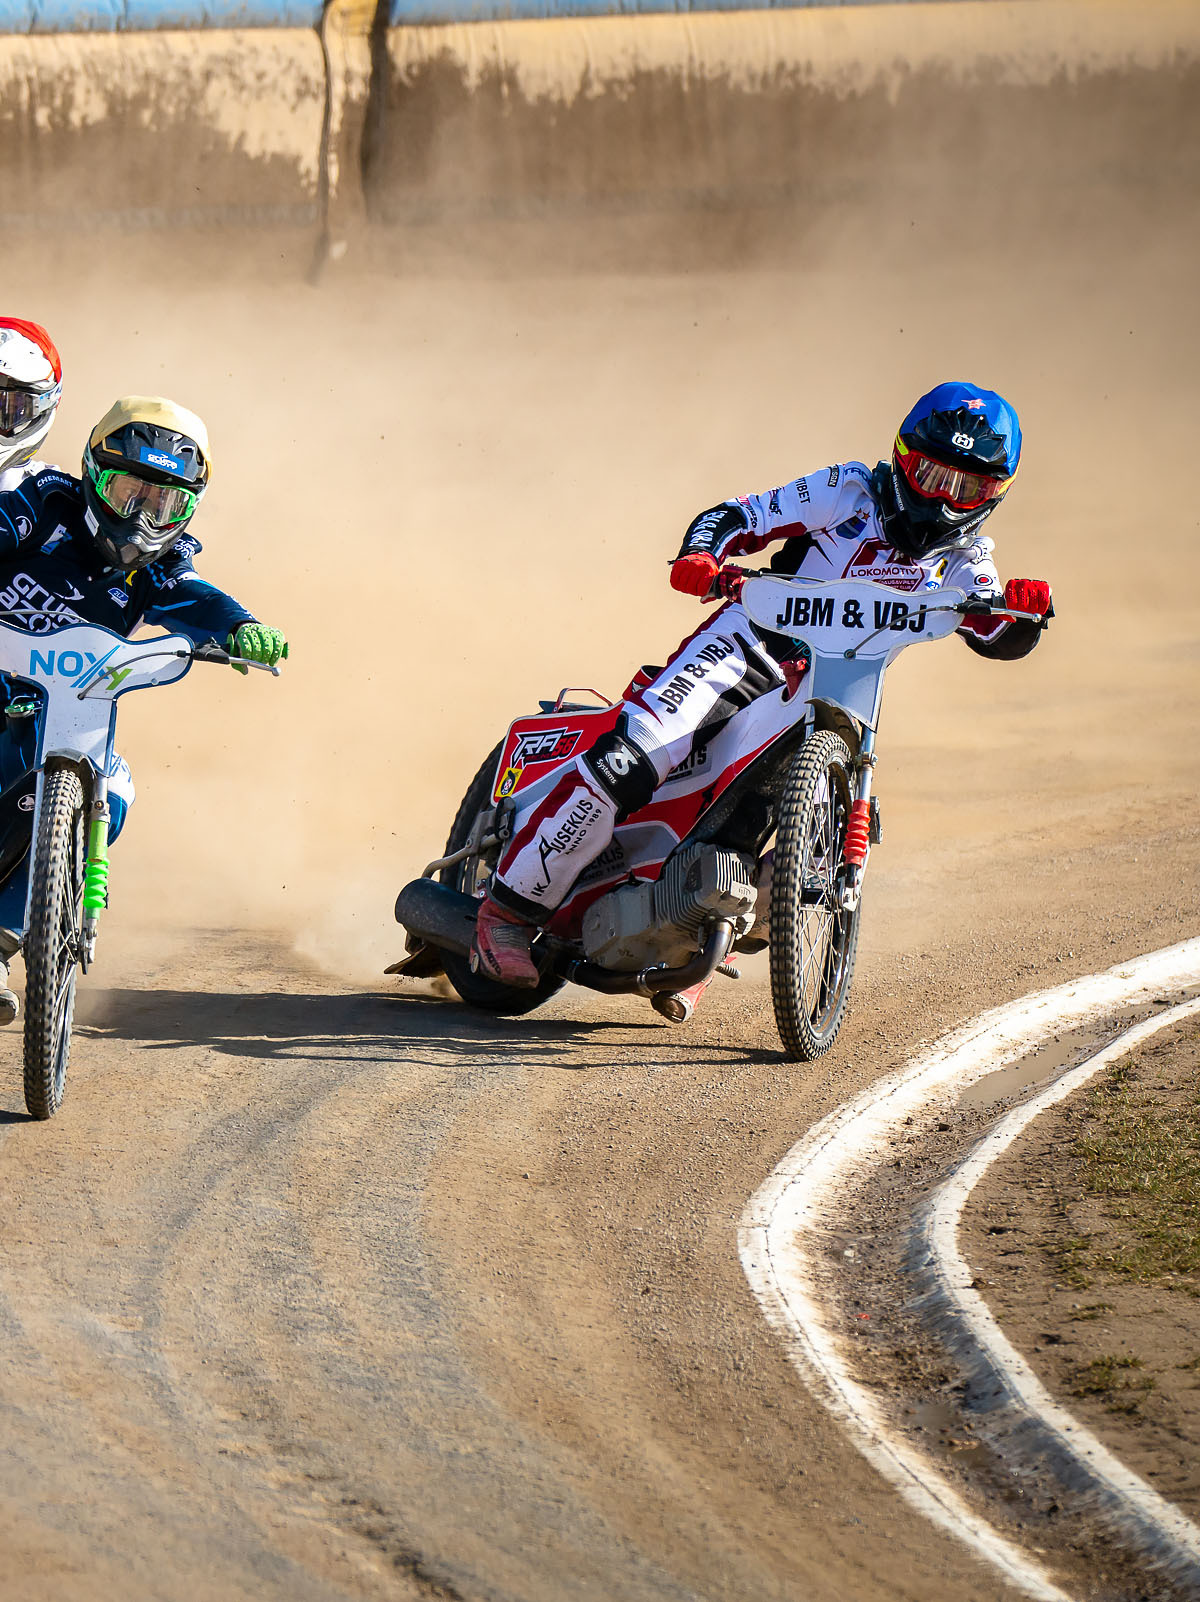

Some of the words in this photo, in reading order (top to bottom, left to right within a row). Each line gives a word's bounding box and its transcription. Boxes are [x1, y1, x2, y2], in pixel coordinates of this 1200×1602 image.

[36, 474, 73, 489] CHEMART
[851, 567, 918, 577] LOKOMOTIV
[776, 597, 835, 627] JBM
[841, 599, 864, 628] &
[874, 600, 928, 633] VBJ
[695, 636, 735, 667] VBJ
[683, 663, 710, 679] &
[657, 675, 696, 714] JBM
[597, 758, 617, 784] Systems
[538, 799, 594, 864] AUSEKLIS
[565, 829, 587, 856] ANNO
[585, 808, 602, 827] 1989
[531, 882, 549, 897] IK
